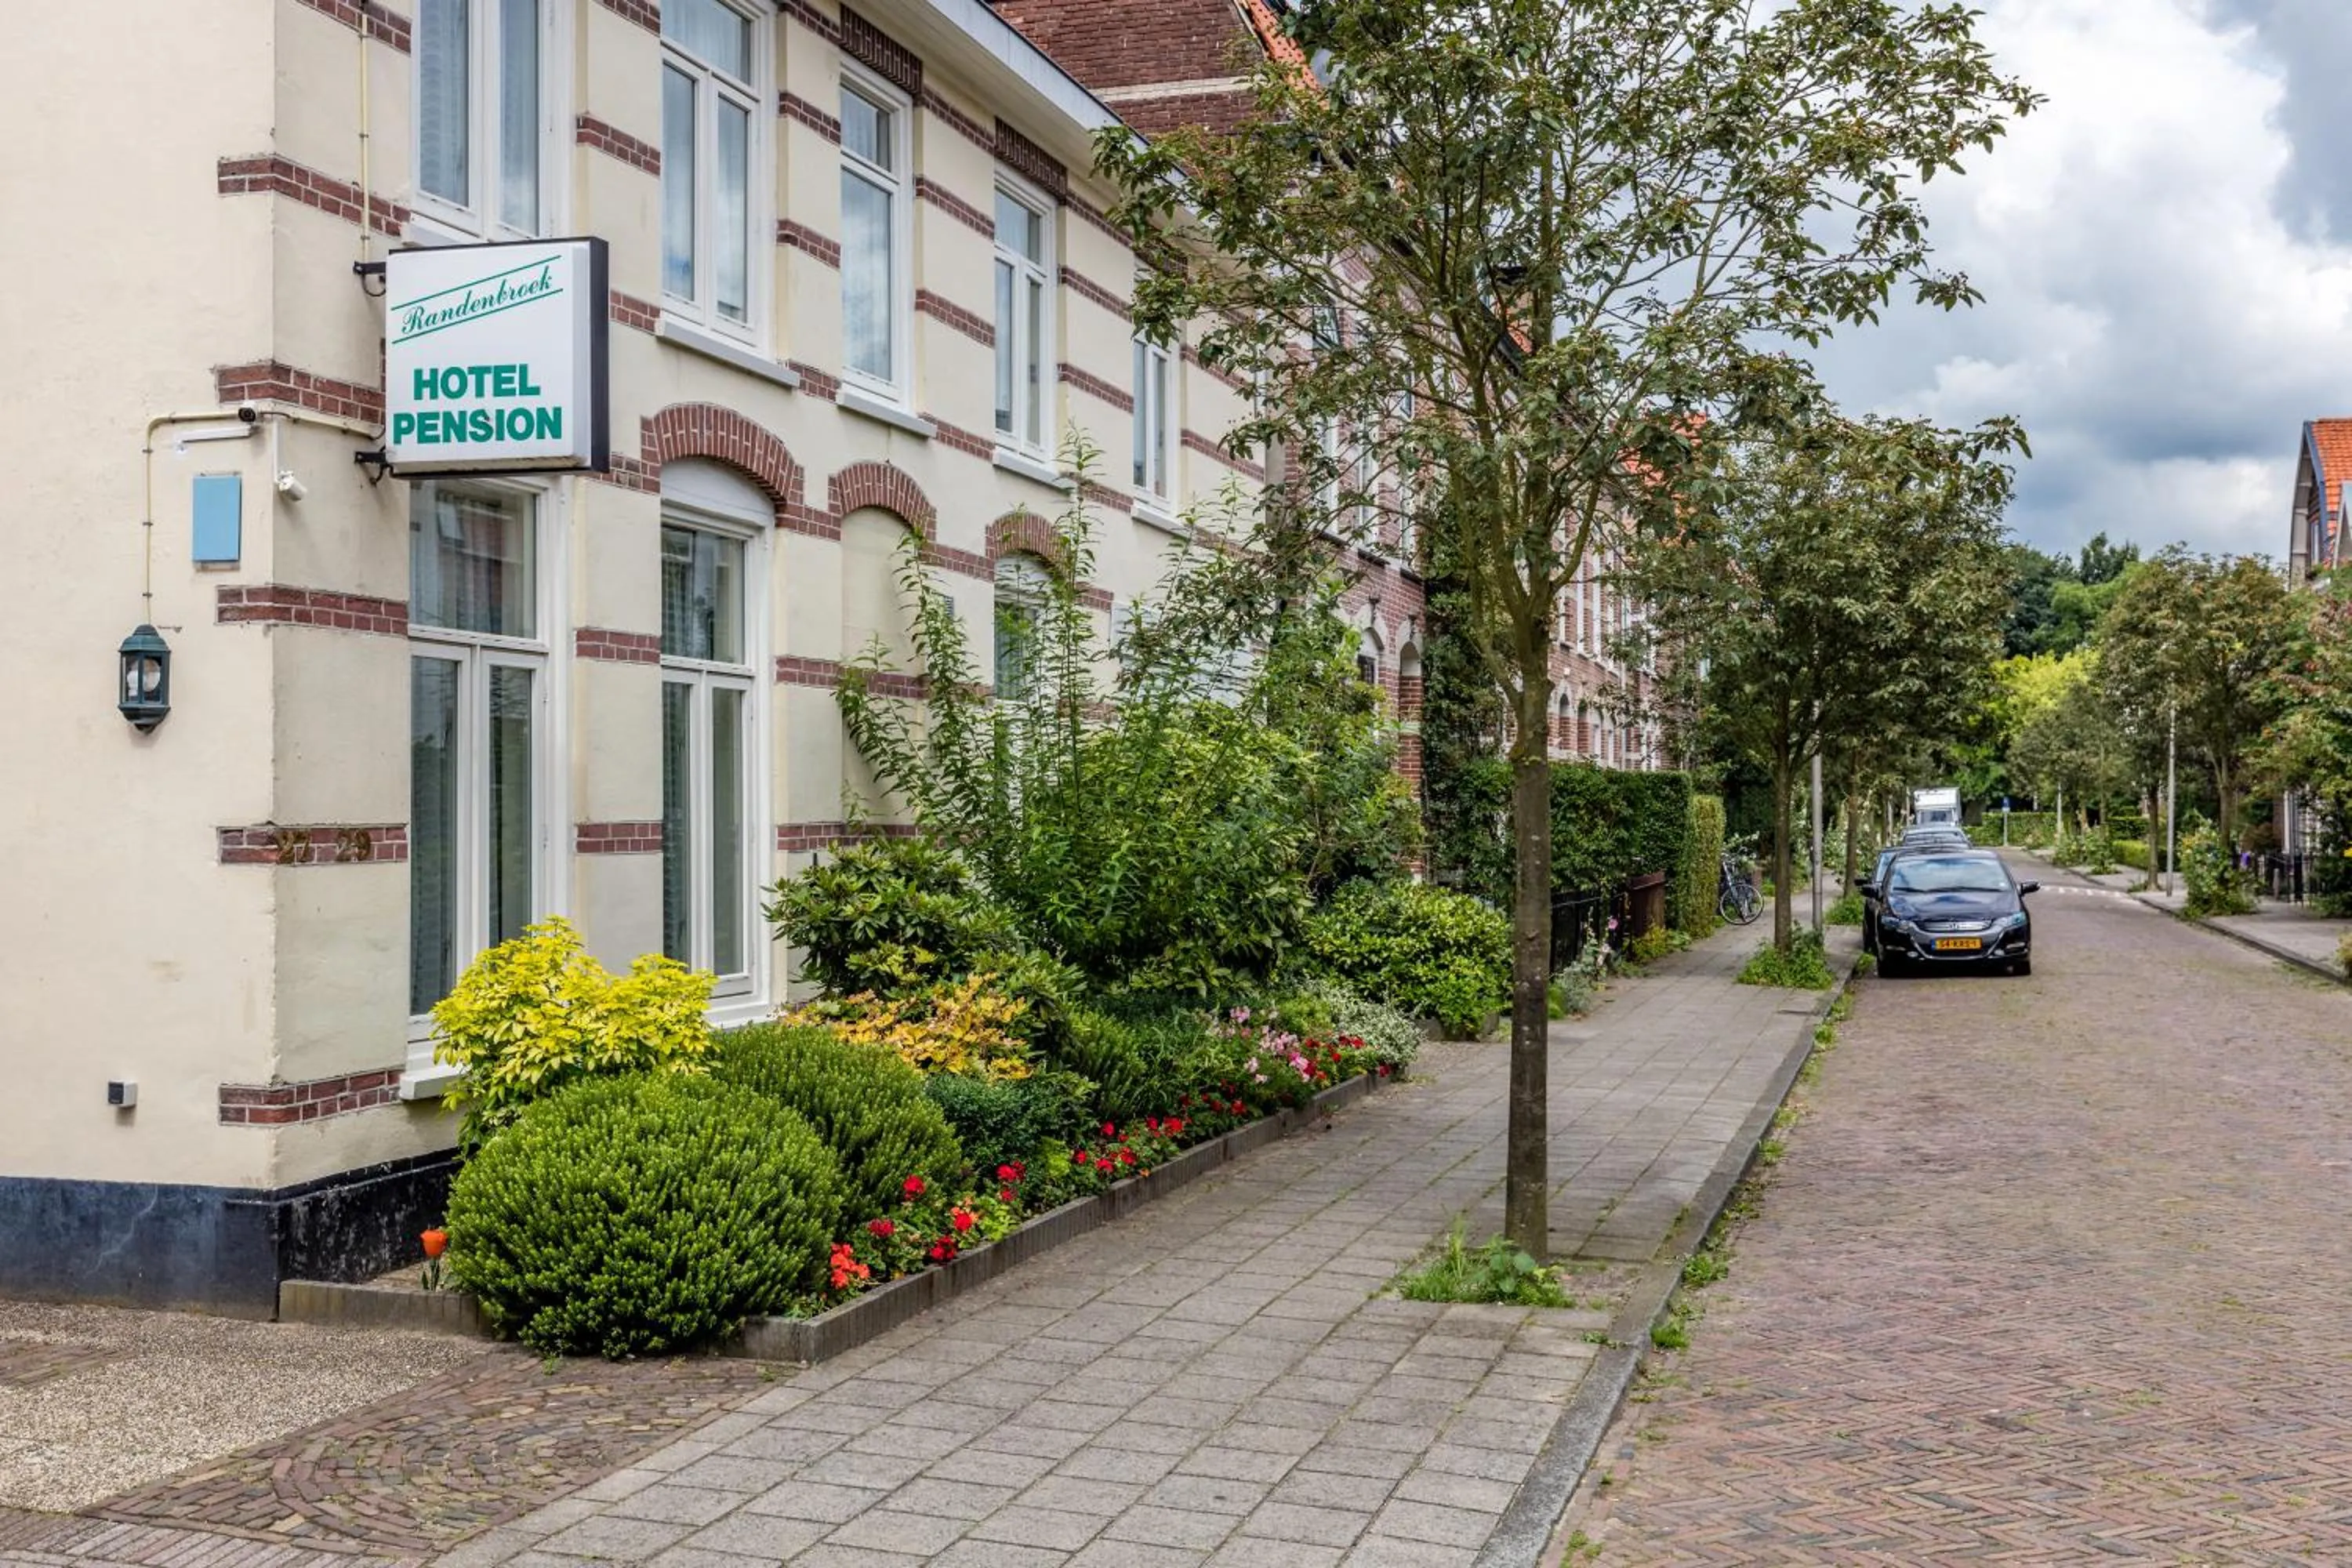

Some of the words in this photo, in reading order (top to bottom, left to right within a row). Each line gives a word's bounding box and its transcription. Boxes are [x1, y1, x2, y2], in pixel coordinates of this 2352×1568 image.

[401, 266, 552, 333] Randenbroek
[413, 364, 540, 401] HOTEL
[393, 406, 562, 445] PENSION
